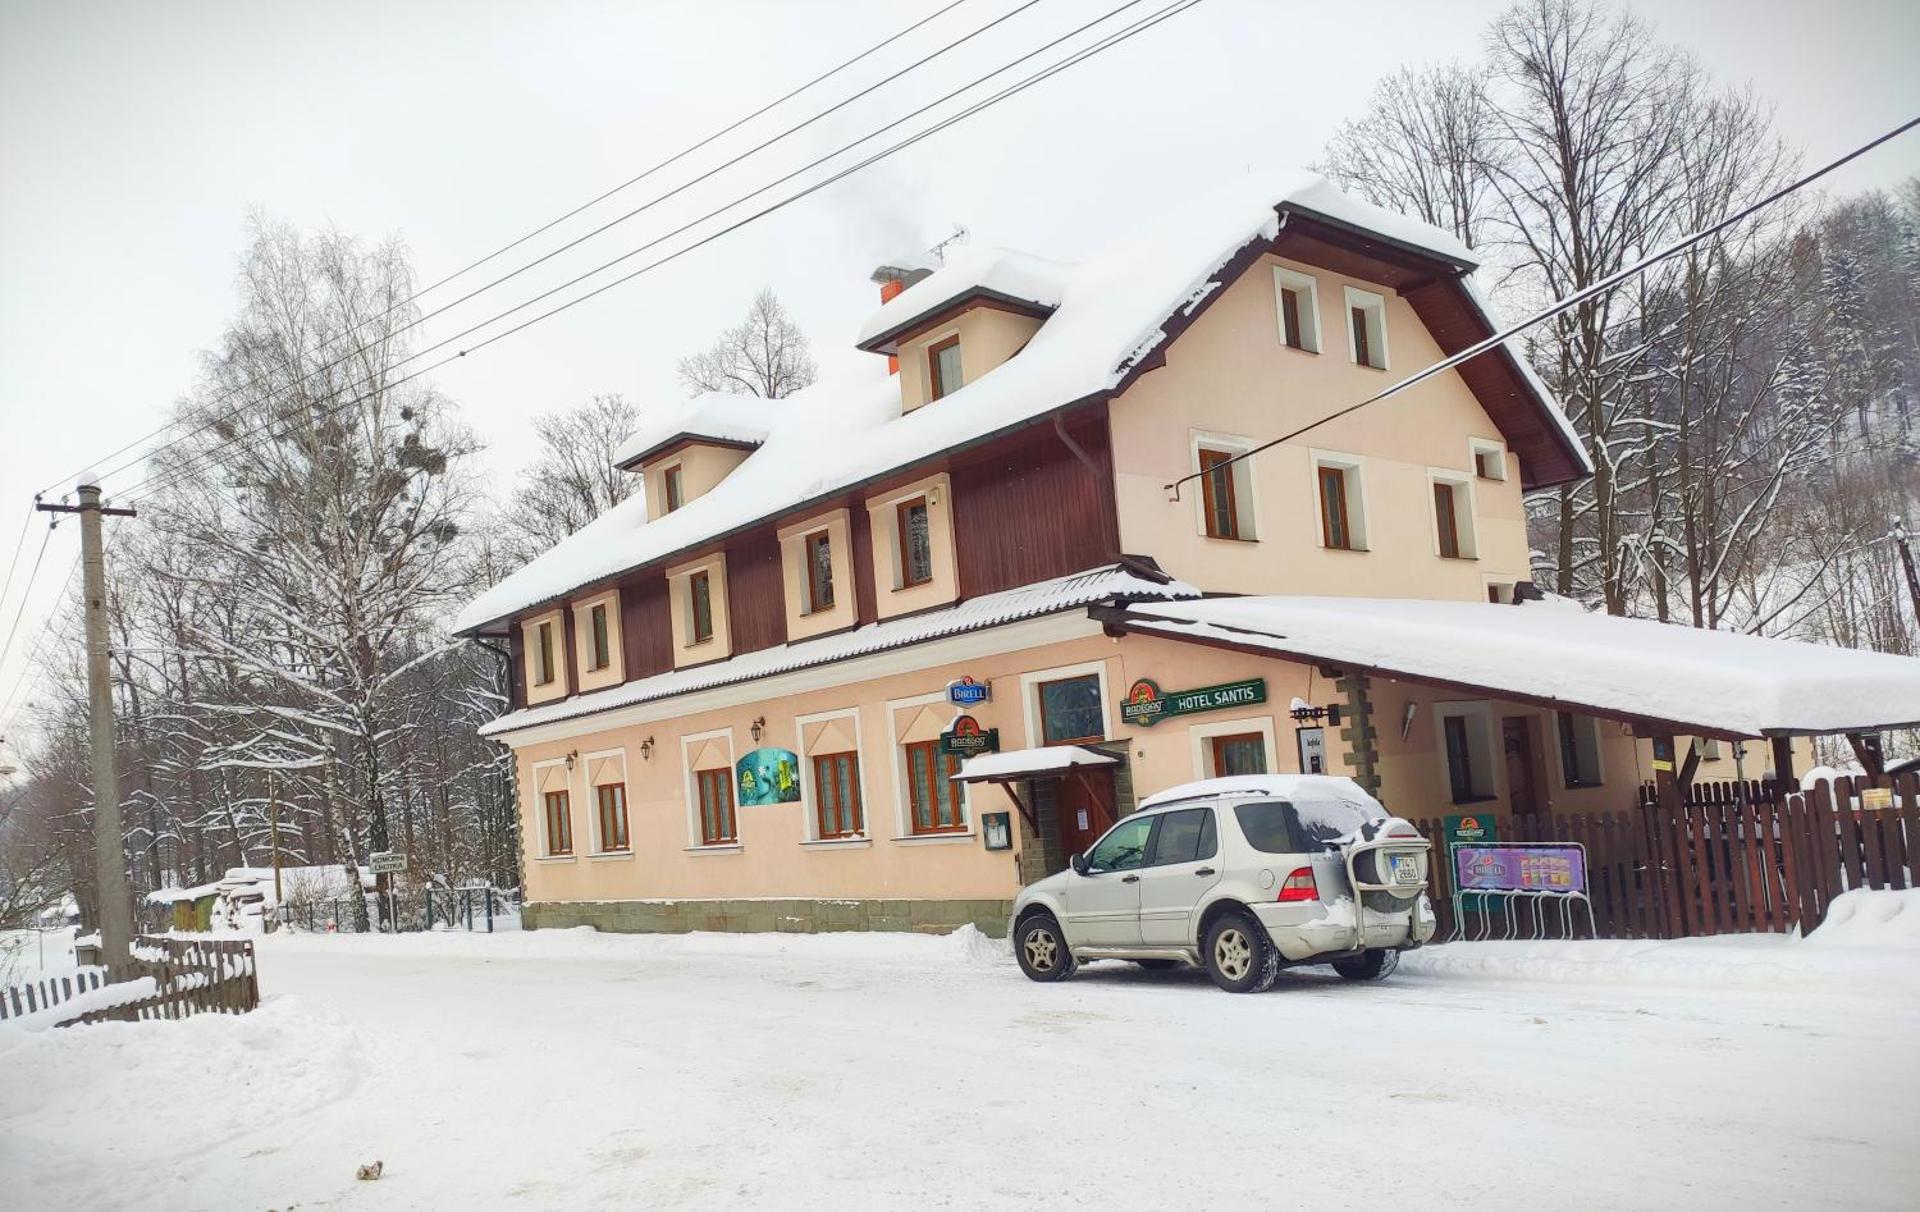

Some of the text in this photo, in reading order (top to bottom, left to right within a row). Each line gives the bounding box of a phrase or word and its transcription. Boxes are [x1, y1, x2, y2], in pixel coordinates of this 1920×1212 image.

[954, 688, 985, 699] BIRELL
[1178, 686, 1255, 711] HOTEL SANTIS
